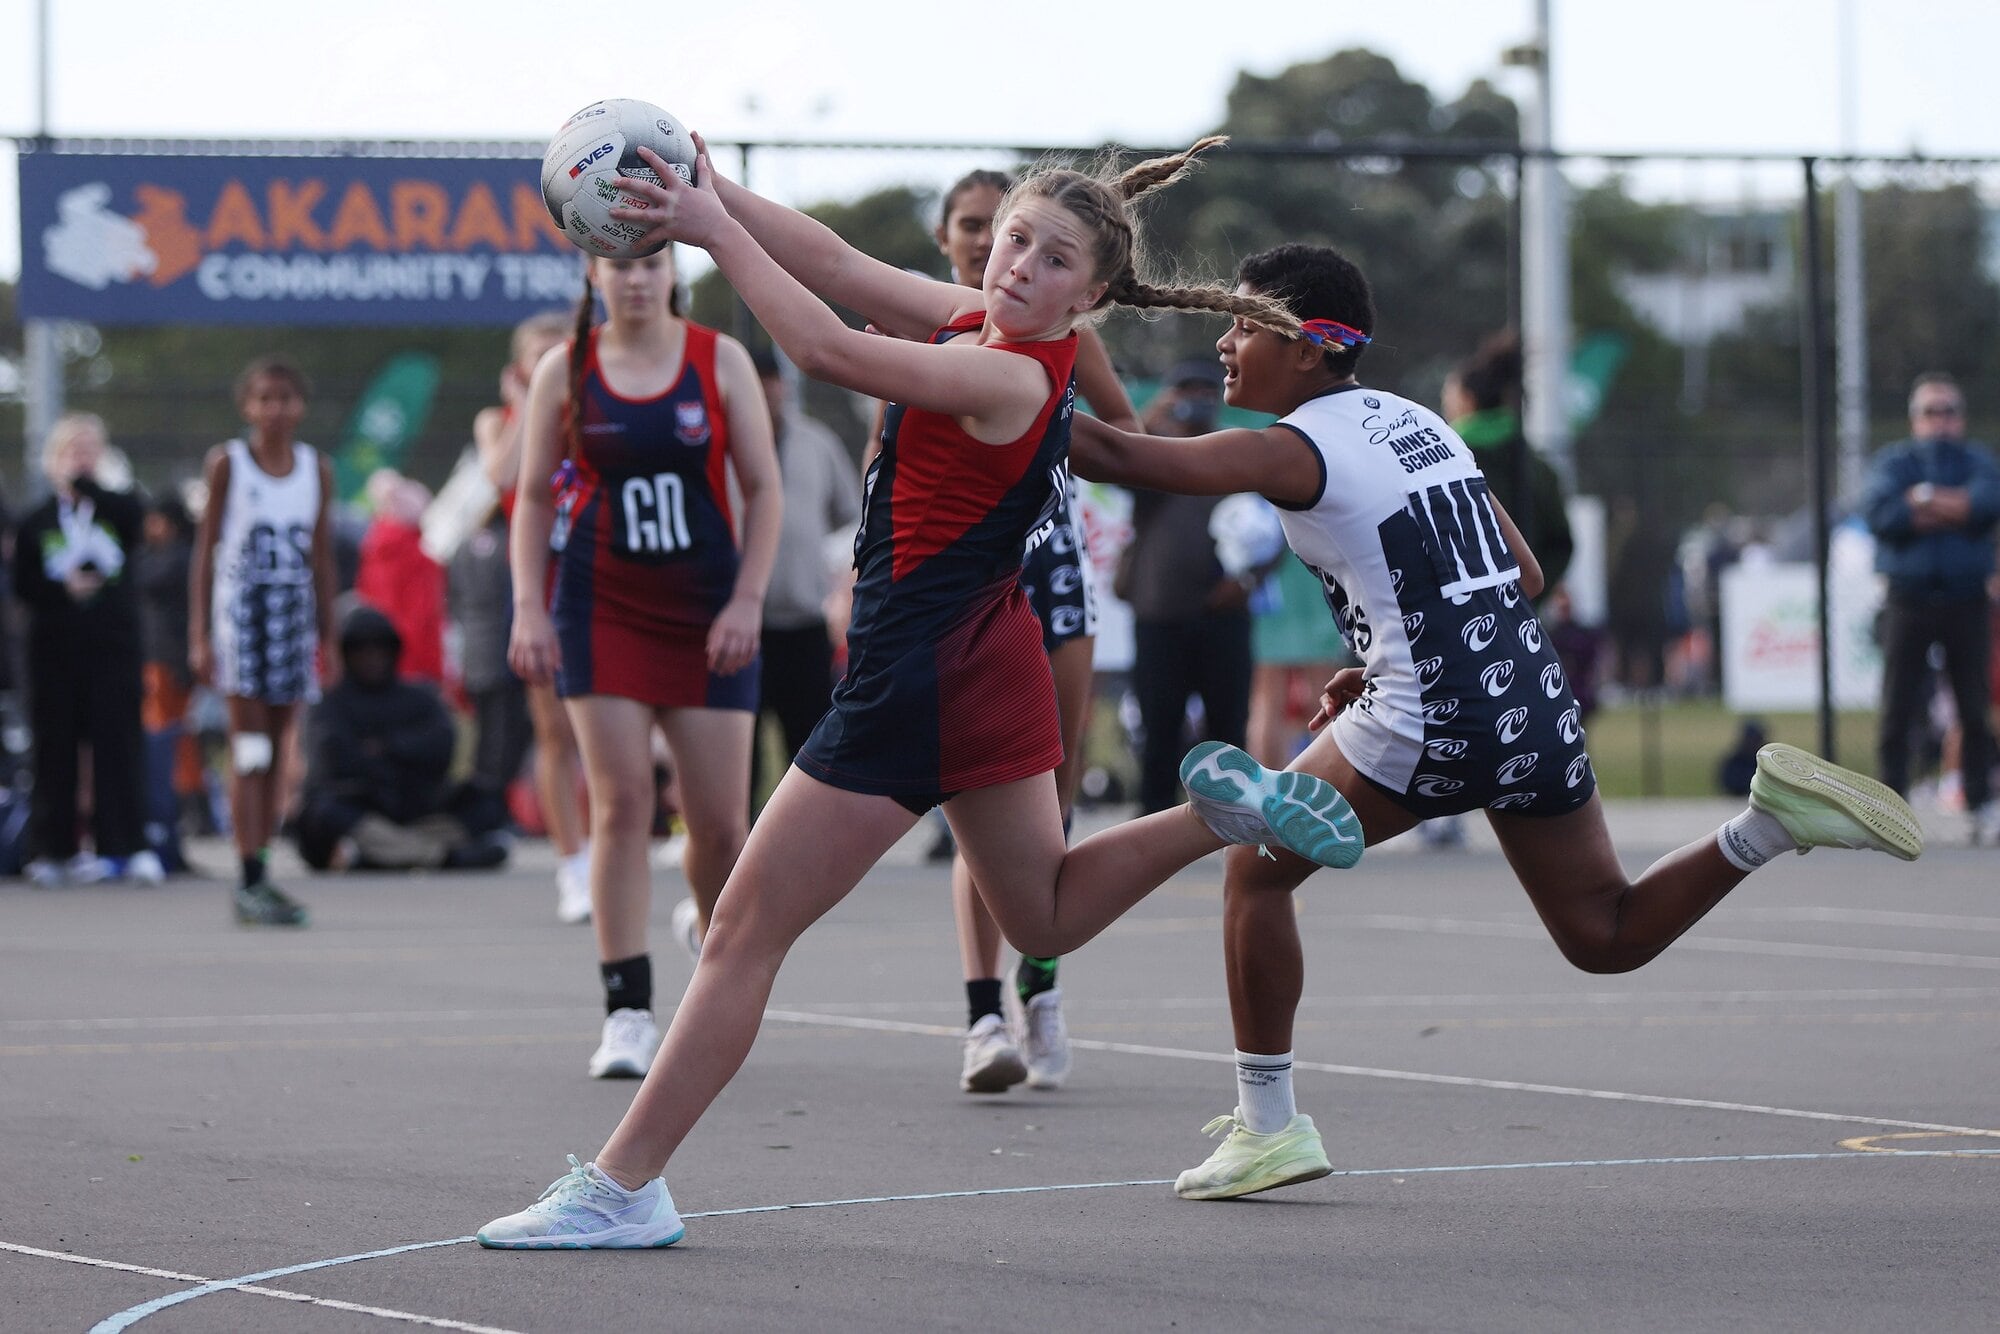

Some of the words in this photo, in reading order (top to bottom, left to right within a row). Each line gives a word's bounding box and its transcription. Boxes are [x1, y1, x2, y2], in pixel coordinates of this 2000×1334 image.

[575, 142, 614, 175] EVES
[594, 176, 619, 195] GAMES
[597, 188, 616, 202] AIMS
[204, 177, 577, 252] AKARAN
[571, 210, 591, 233] GAMES
[601, 223, 639, 244] ILVER
[616, 222, 646, 238] ERN
[196, 253, 492, 300] COMMUNITY
[497, 255, 588, 299] TRU
[1362, 408, 1420, 445] Saint
[1388, 427, 1441, 456] ANNE'S
[1399, 443, 1456, 474] SCHOOL
[1408, 476, 1520, 588] WD
